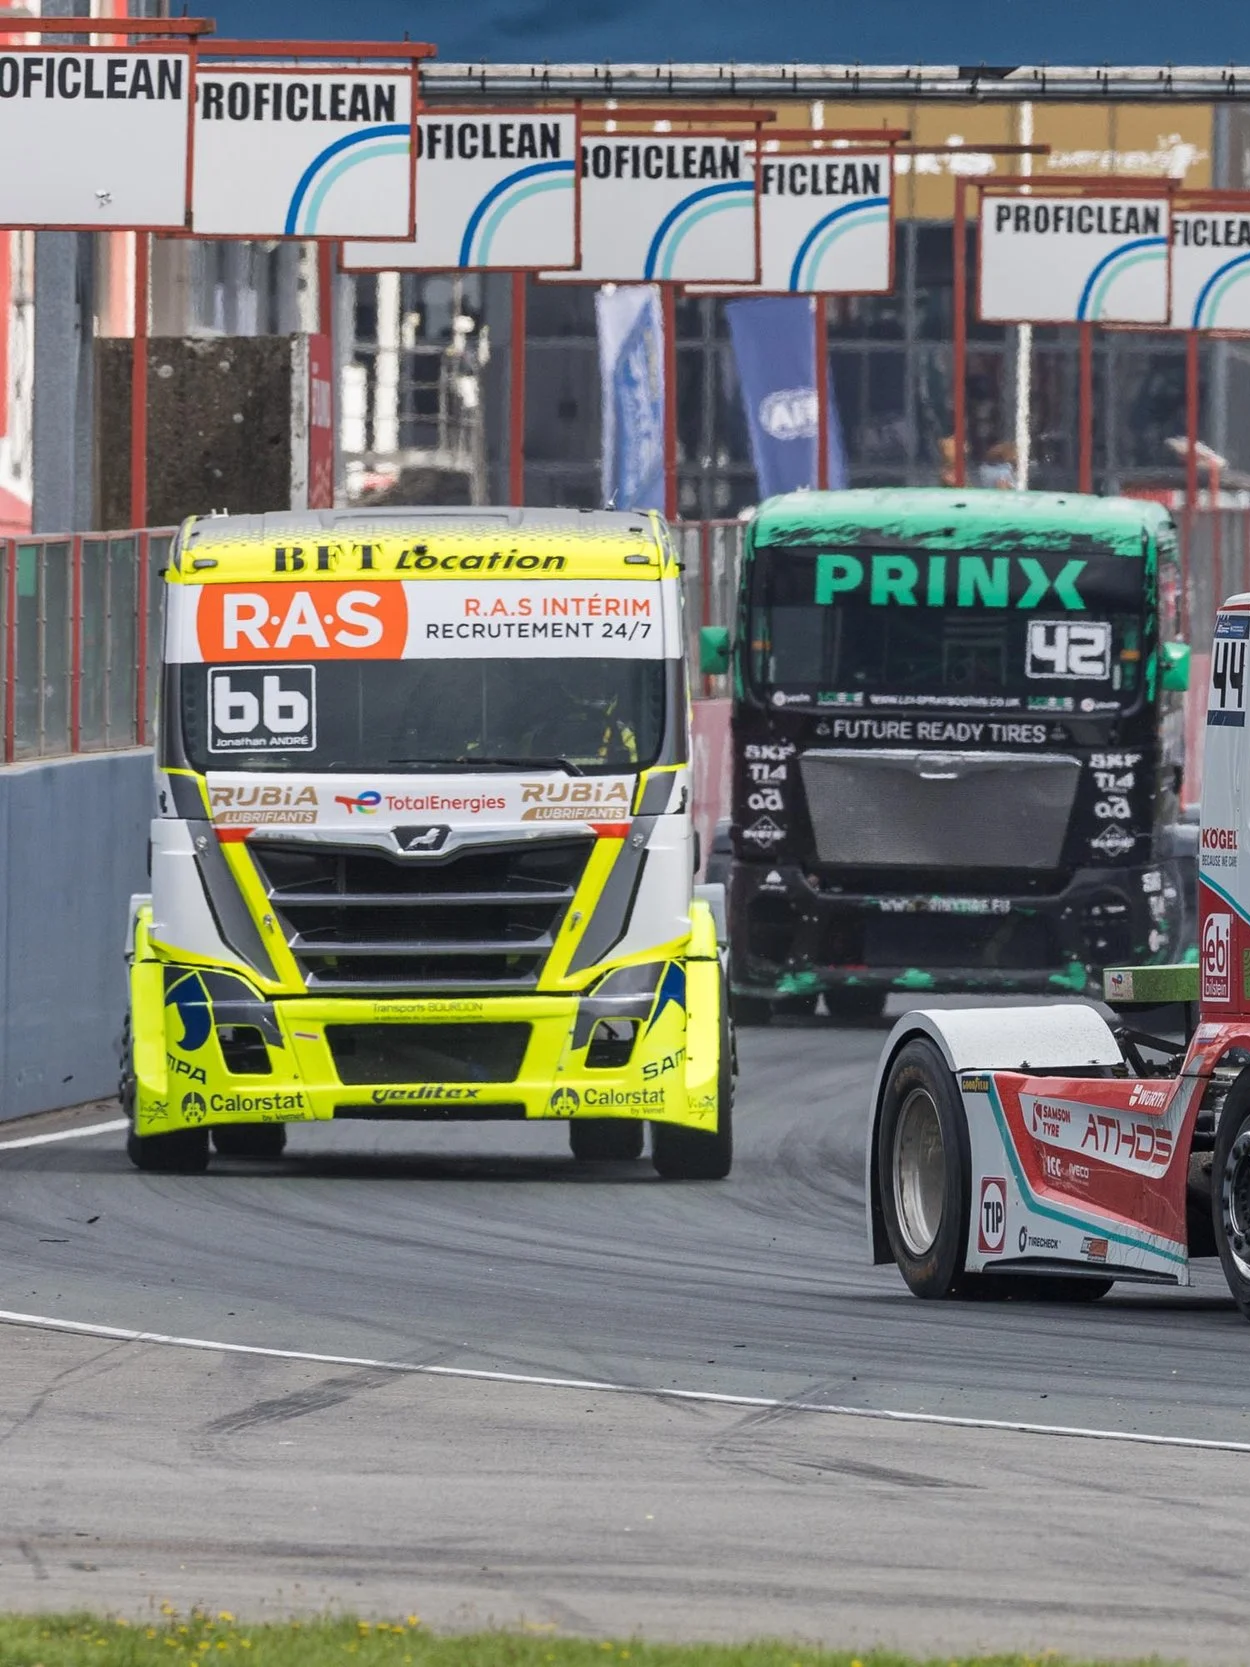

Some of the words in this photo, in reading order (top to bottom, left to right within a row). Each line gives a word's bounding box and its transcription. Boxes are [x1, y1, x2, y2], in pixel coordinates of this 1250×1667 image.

[196, 82, 396, 122] ROFICLEAN
[995, 204, 1160, 235] PROFICLEAN
[395, 548, 567, 571] Location
[815, 553, 1087, 610] PRINX
[464, 597, 532, 617] R.A.S
[543, 593, 650, 617] INTÉRIM
[426, 623, 594, 639] RECRUTEMENT
[601, 621, 652, 641] 24/7
[1031, 625, 1103, 675] 42
[1213, 642, 1246, 709] 44
[216, 737, 267, 747] Jonathan
[833, 720, 912, 739] FUTURE
[917, 721, 982, 742] READY
[989, 722, 1047, 744] TIRES
[385, 794, 507, 812] TotalEnergies
[535, 806, 624, 820] LUBRIFIANTS
[225, 810, 314, 823] LUBRIFIANTS
[1205, 977, 1227, 997] bilstein
[210, 1093, 304, 1112] Calorstat
[584, 1087, 665, 1105] Calorstat
[1043, 1104, 1071, 1124] SAMSON
[1043, 1121, 1060, 1137] TYRE
[984, 1201, 1003, 1226] TIP
[1028, 1236, 1059, 1250] TIRECHECK
